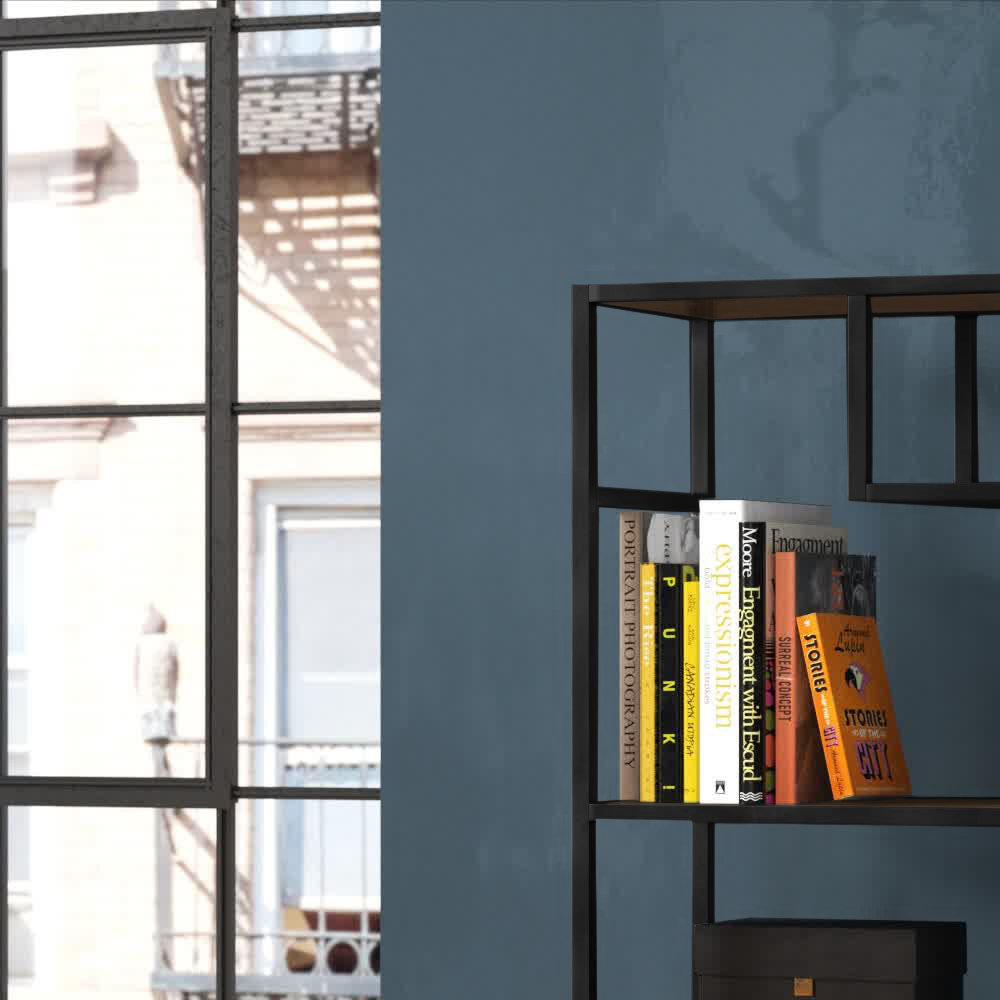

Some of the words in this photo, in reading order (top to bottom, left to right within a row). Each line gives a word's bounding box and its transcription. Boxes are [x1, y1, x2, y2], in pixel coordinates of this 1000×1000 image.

[624, 519, 637, 616] PORTRAIT
[742, 526, 758, 578] Moore
[711, 543, 737, 729] expressionism
[778, 636, 791, 677] SURREAL
[803, 633, 828, 693] STORIES
[624, 622, 637, 769] PHOTOGRAPHY
[742, 687, 761, 727] with
[778, 681, 791, 722] CONCEPT
[844, 709, 888, 727] STORIES
